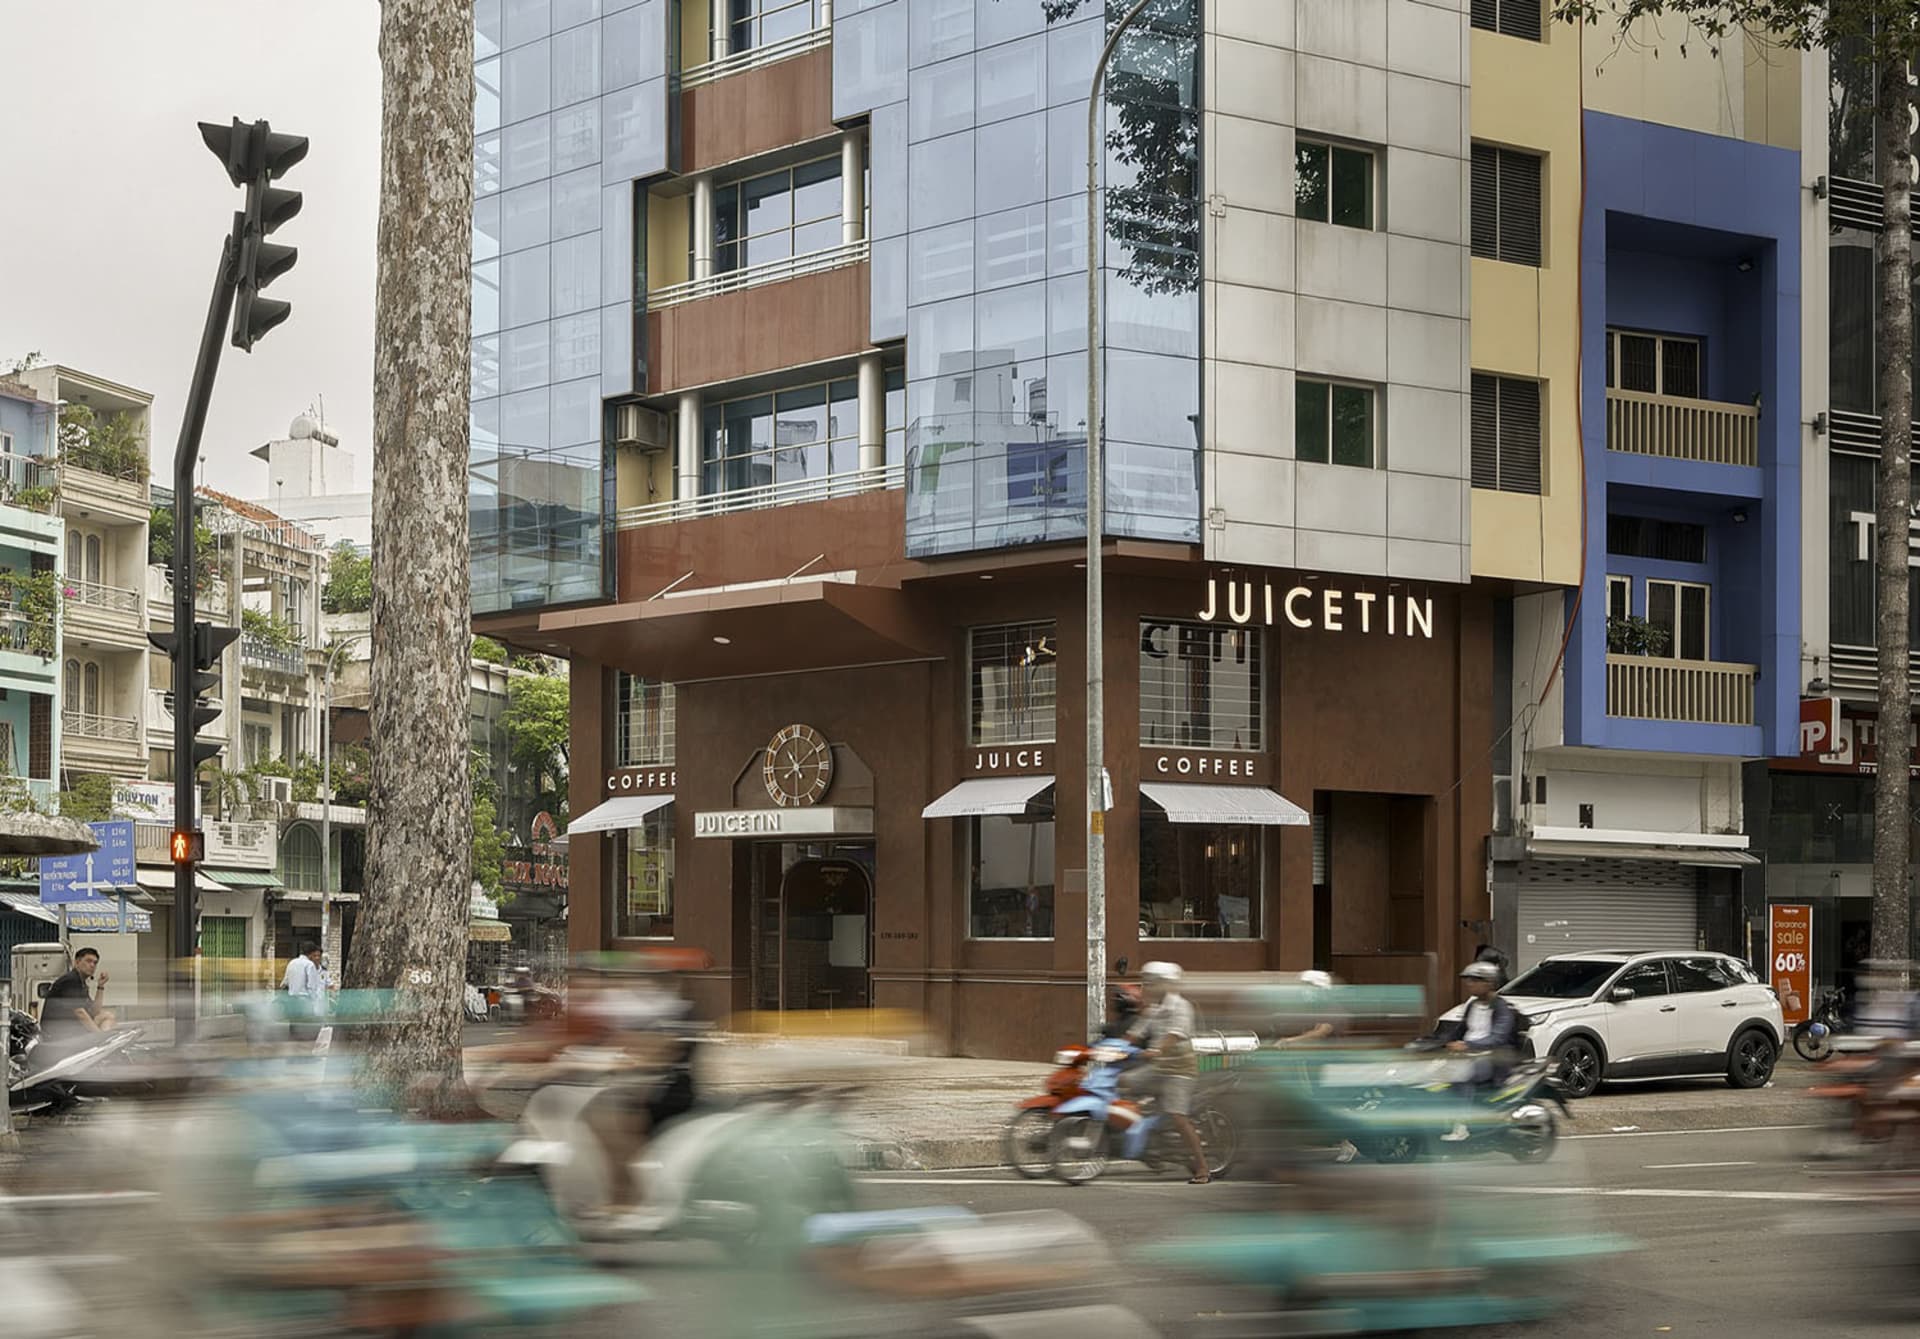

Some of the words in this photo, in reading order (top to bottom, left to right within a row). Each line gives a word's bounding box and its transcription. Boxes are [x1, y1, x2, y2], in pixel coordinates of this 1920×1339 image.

[1199, 579, 1433, 638] JUICETIN
[975, 751, 1042, 769] JUICE
[1157, 756, 1254, 776] COFFEE
[607, 772, 676, 790] COFFEE
[698, 814, 779, 833] JUICETIN
[1777, 930, 1804, 945] sale
[1775, 953, 1806, 972] 60%
[409, 970, 432, 984] 56
